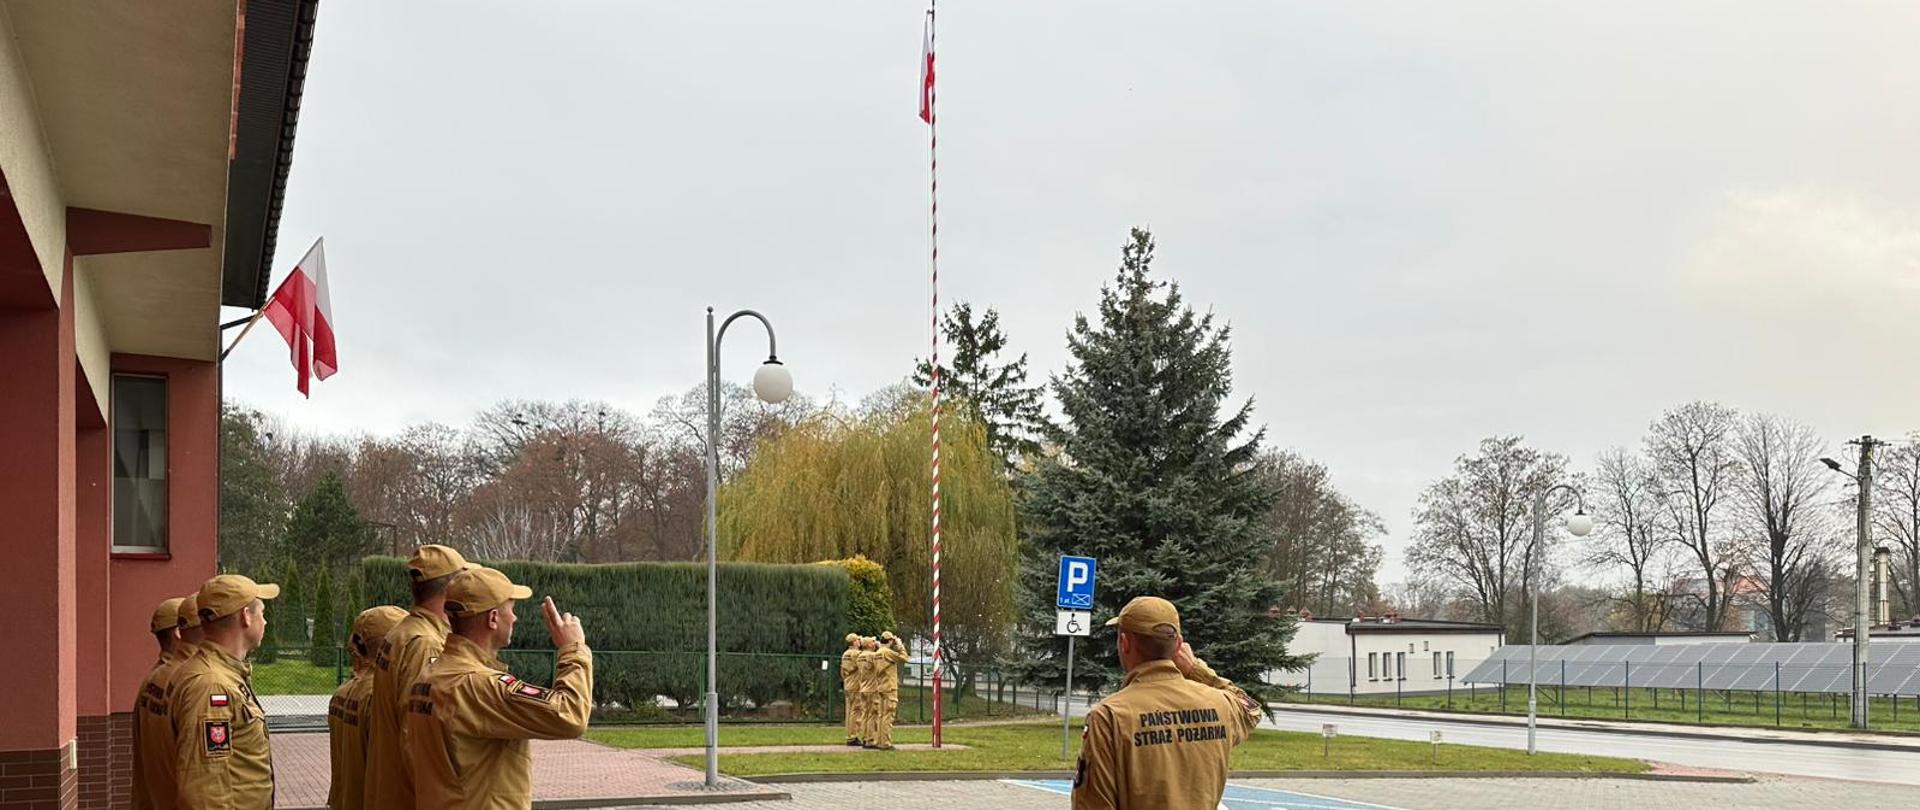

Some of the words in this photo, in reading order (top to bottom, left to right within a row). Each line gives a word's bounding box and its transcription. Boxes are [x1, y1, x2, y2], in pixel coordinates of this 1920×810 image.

[1067, 561, 1088, 592] P
[1139, 708, 1219, 727] PAŃSTWOWA
[1134, 728, 1173, 747] STRAŻ
[1177, 725, 1227, 742] POŻARNA
